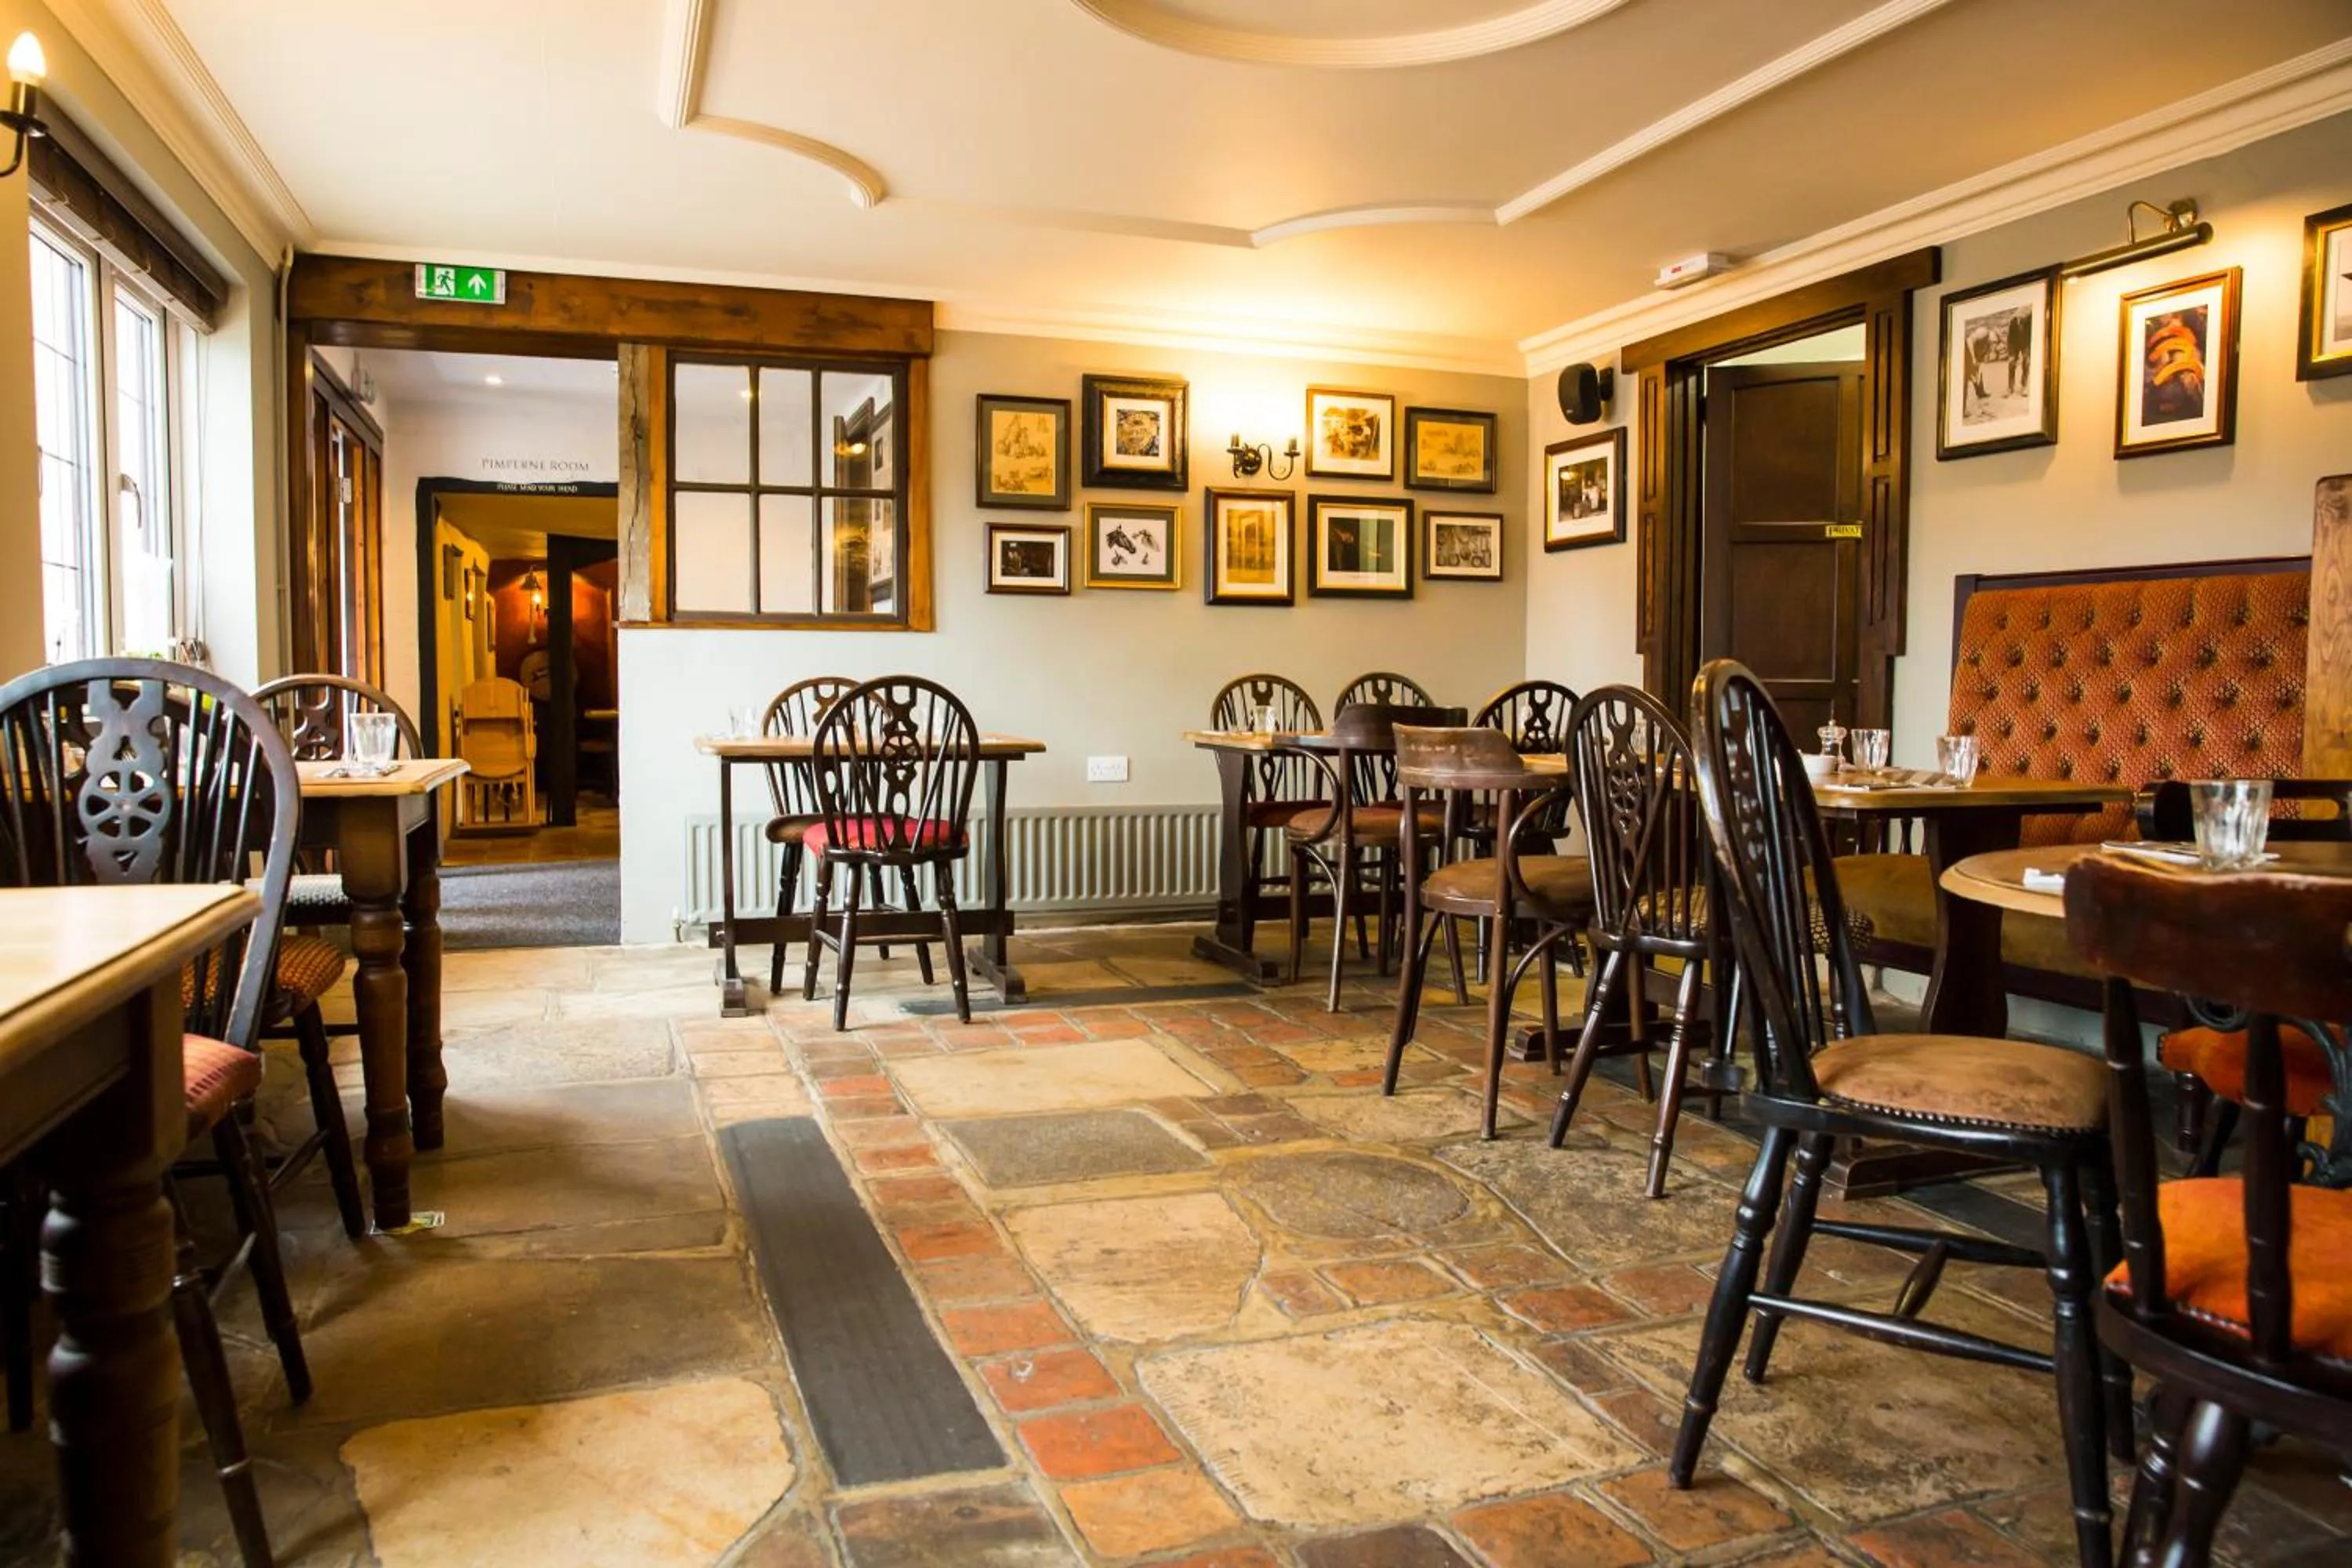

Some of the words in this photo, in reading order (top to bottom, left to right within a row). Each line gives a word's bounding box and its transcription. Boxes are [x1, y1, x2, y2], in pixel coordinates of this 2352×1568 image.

[482, 459, 544, 470] PIMPERNE
[550, 460, 589, 472] ROOM
[1832, 526, 1860, 535] PRIVAT
